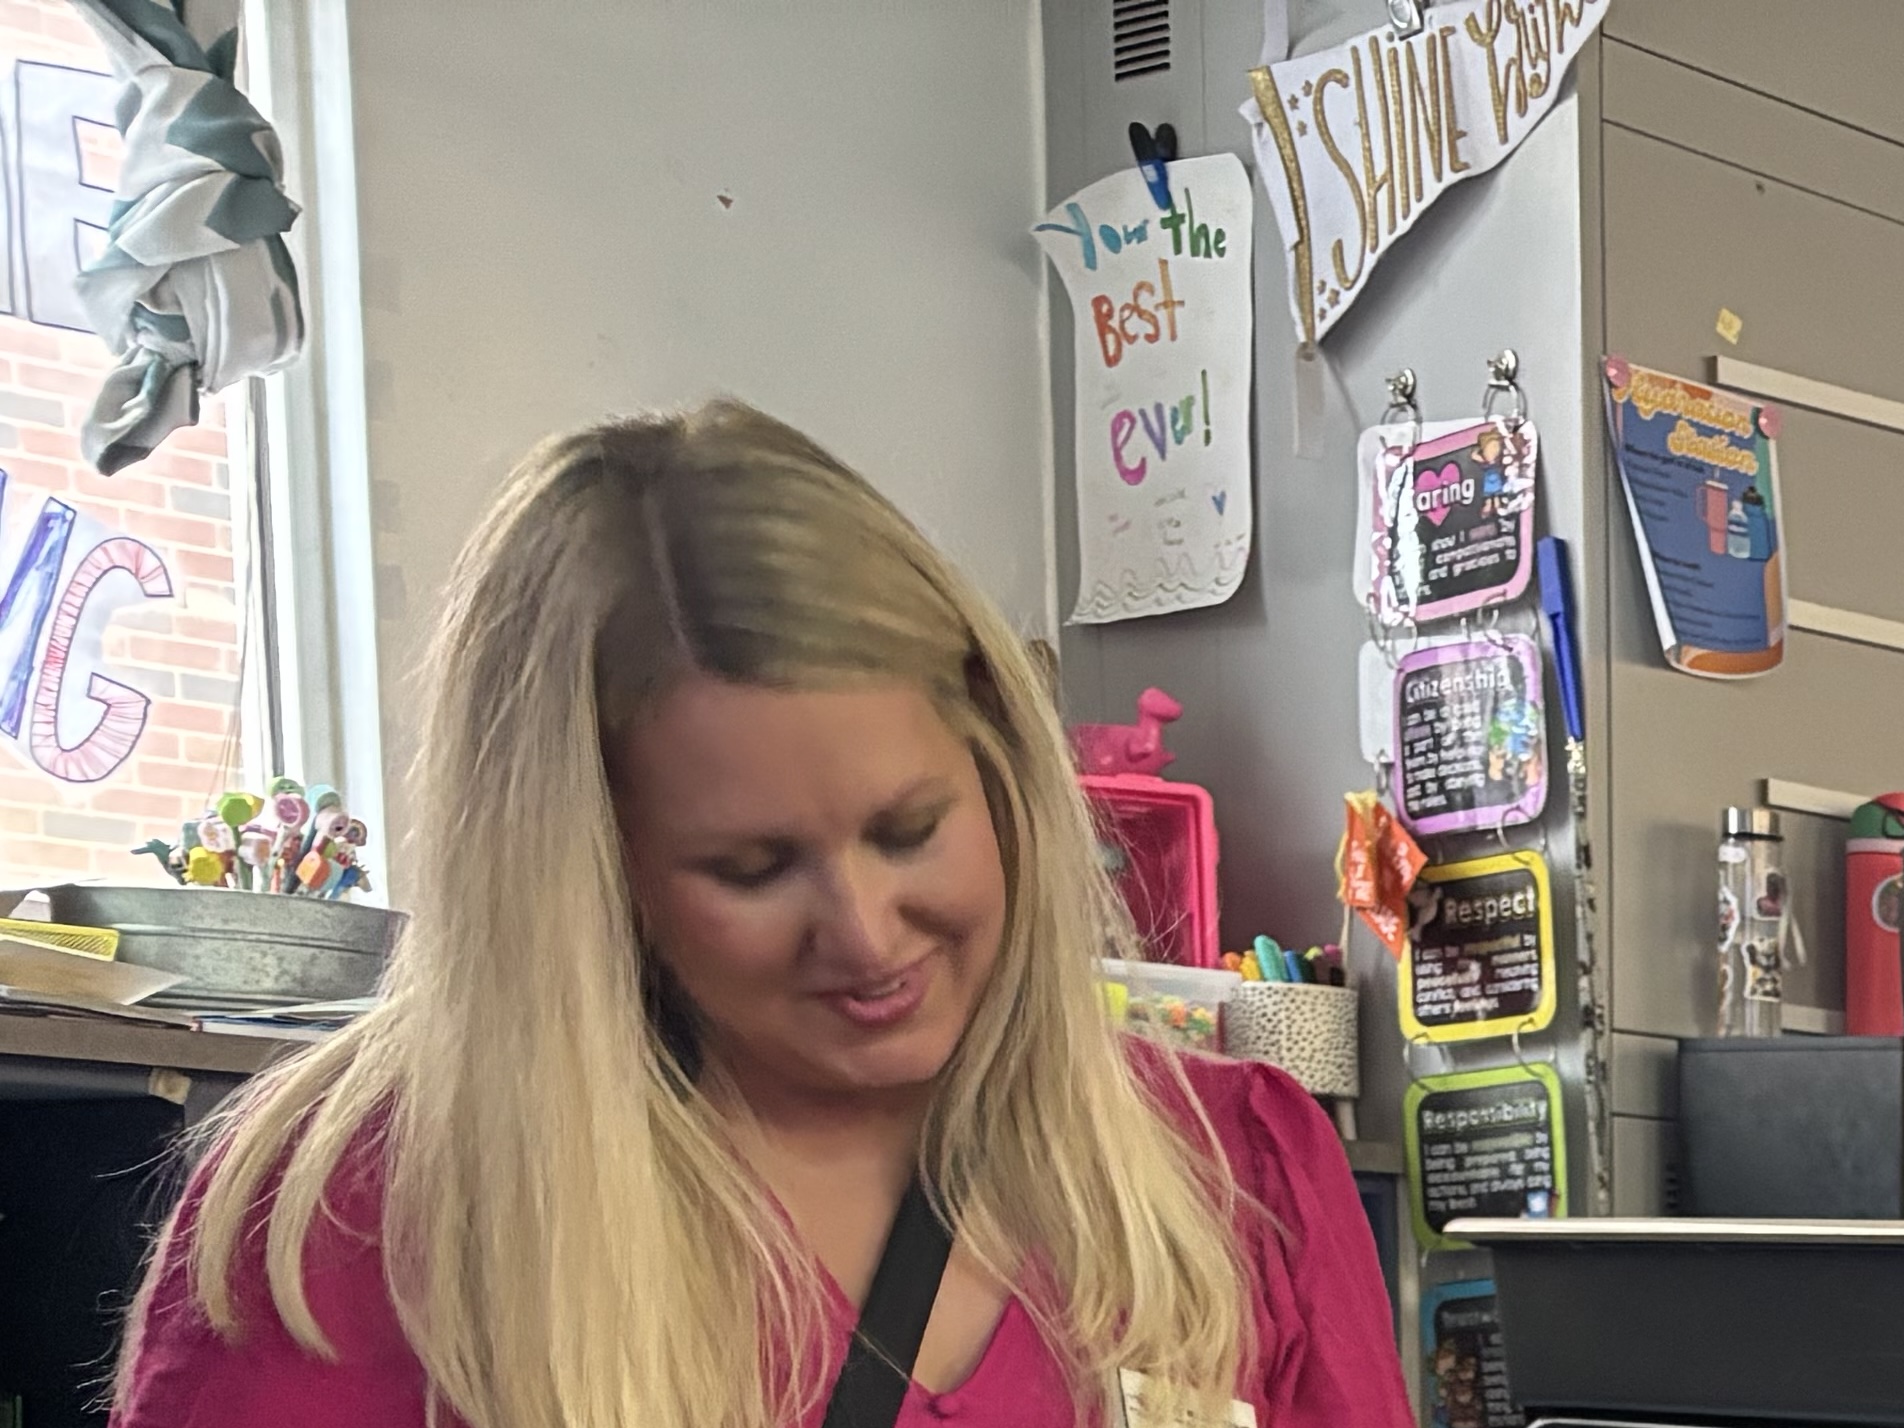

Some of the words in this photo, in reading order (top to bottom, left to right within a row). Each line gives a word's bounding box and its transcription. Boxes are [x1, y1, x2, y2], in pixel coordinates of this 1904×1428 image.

[1160, 187, 1227, 259] the
[1404, 477, 1475, 513] aring
[1444, 884, 1536, 926] Respect
